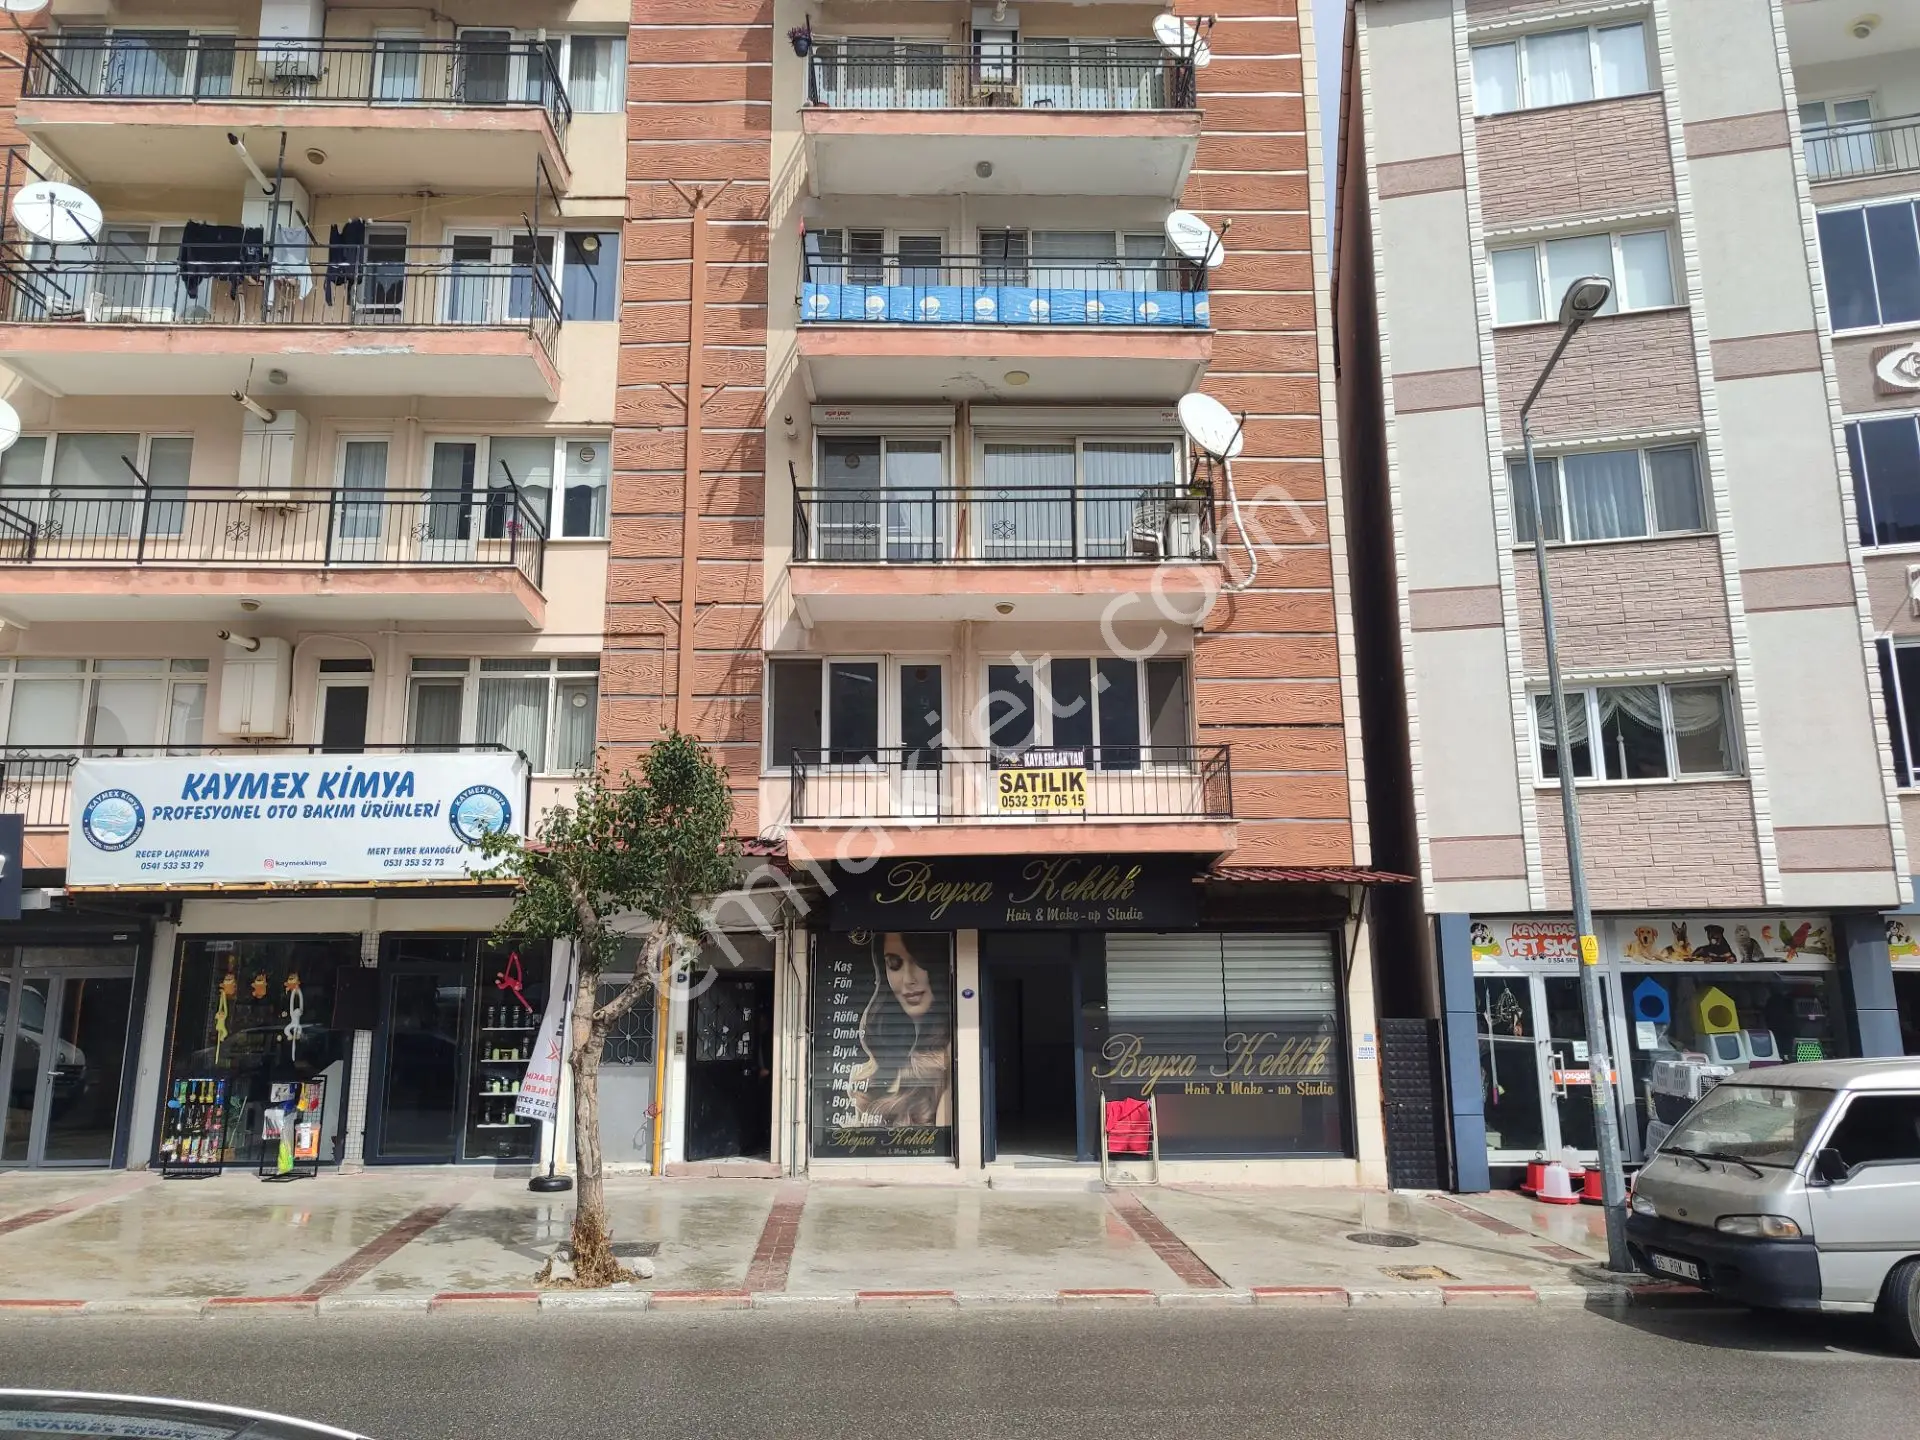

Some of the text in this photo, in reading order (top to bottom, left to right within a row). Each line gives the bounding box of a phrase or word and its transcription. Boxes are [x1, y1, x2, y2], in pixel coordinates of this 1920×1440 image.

[1024, 752, 1043, 767] KAYA
[181, 765, 415, 802] KAYMEX KİMYA
[1000, 772, 1085, 793] SATILIK
[88, 790, 119, 810] KAYMEX
[455, 786, 486, 807] KAYMEX
[1002, 794, 1085, 808] 0532 377 05 15
[152, 800, 442, 821] PROFESYONEL OTO BAKIM ÜRÜNLERİ
[136, 850, 162, 859] RECEP
[367, 845, 462, 855] MERT EMRE KAYAOĞLU
[140, 861, 204, 870] 0541 533 53 29
[383, 858, 445, 867] 0531 353 52 73
[876, 859, 1142, 920] Beyza Keklik
[1006, 908, 1031, 922] Hair
[1035, 908, 1044, 921] &
[1107, 907, 1144, 921] Studio
[1506, 938, 1539, 957] PET
[834, 960, 853, 974] Kaş
[833, 976, 853, 989] Fön
[832, 1010, 859, 1023] Röfle
[832, 1027, 866, 1040] Ombre
[832, 1045, 858, 1060] Bıyık
[832, 1062, 863, 1074] Kesim
[1092, 1032, 1332, 1096] Beyza Keklik
[832, 1078, 870, 1093] Makyaj
[1184, 1081, 1211, 1095] Hair
[1216, 1081, 1225, 1095] &
[1231, 1081, 1264, 1095] Make
[1296, 1080, 1334, 1096] Studio
[832, 1095, 857, 1110] Boya
[827, 1127, 939, 1154] Beyza Keklik
